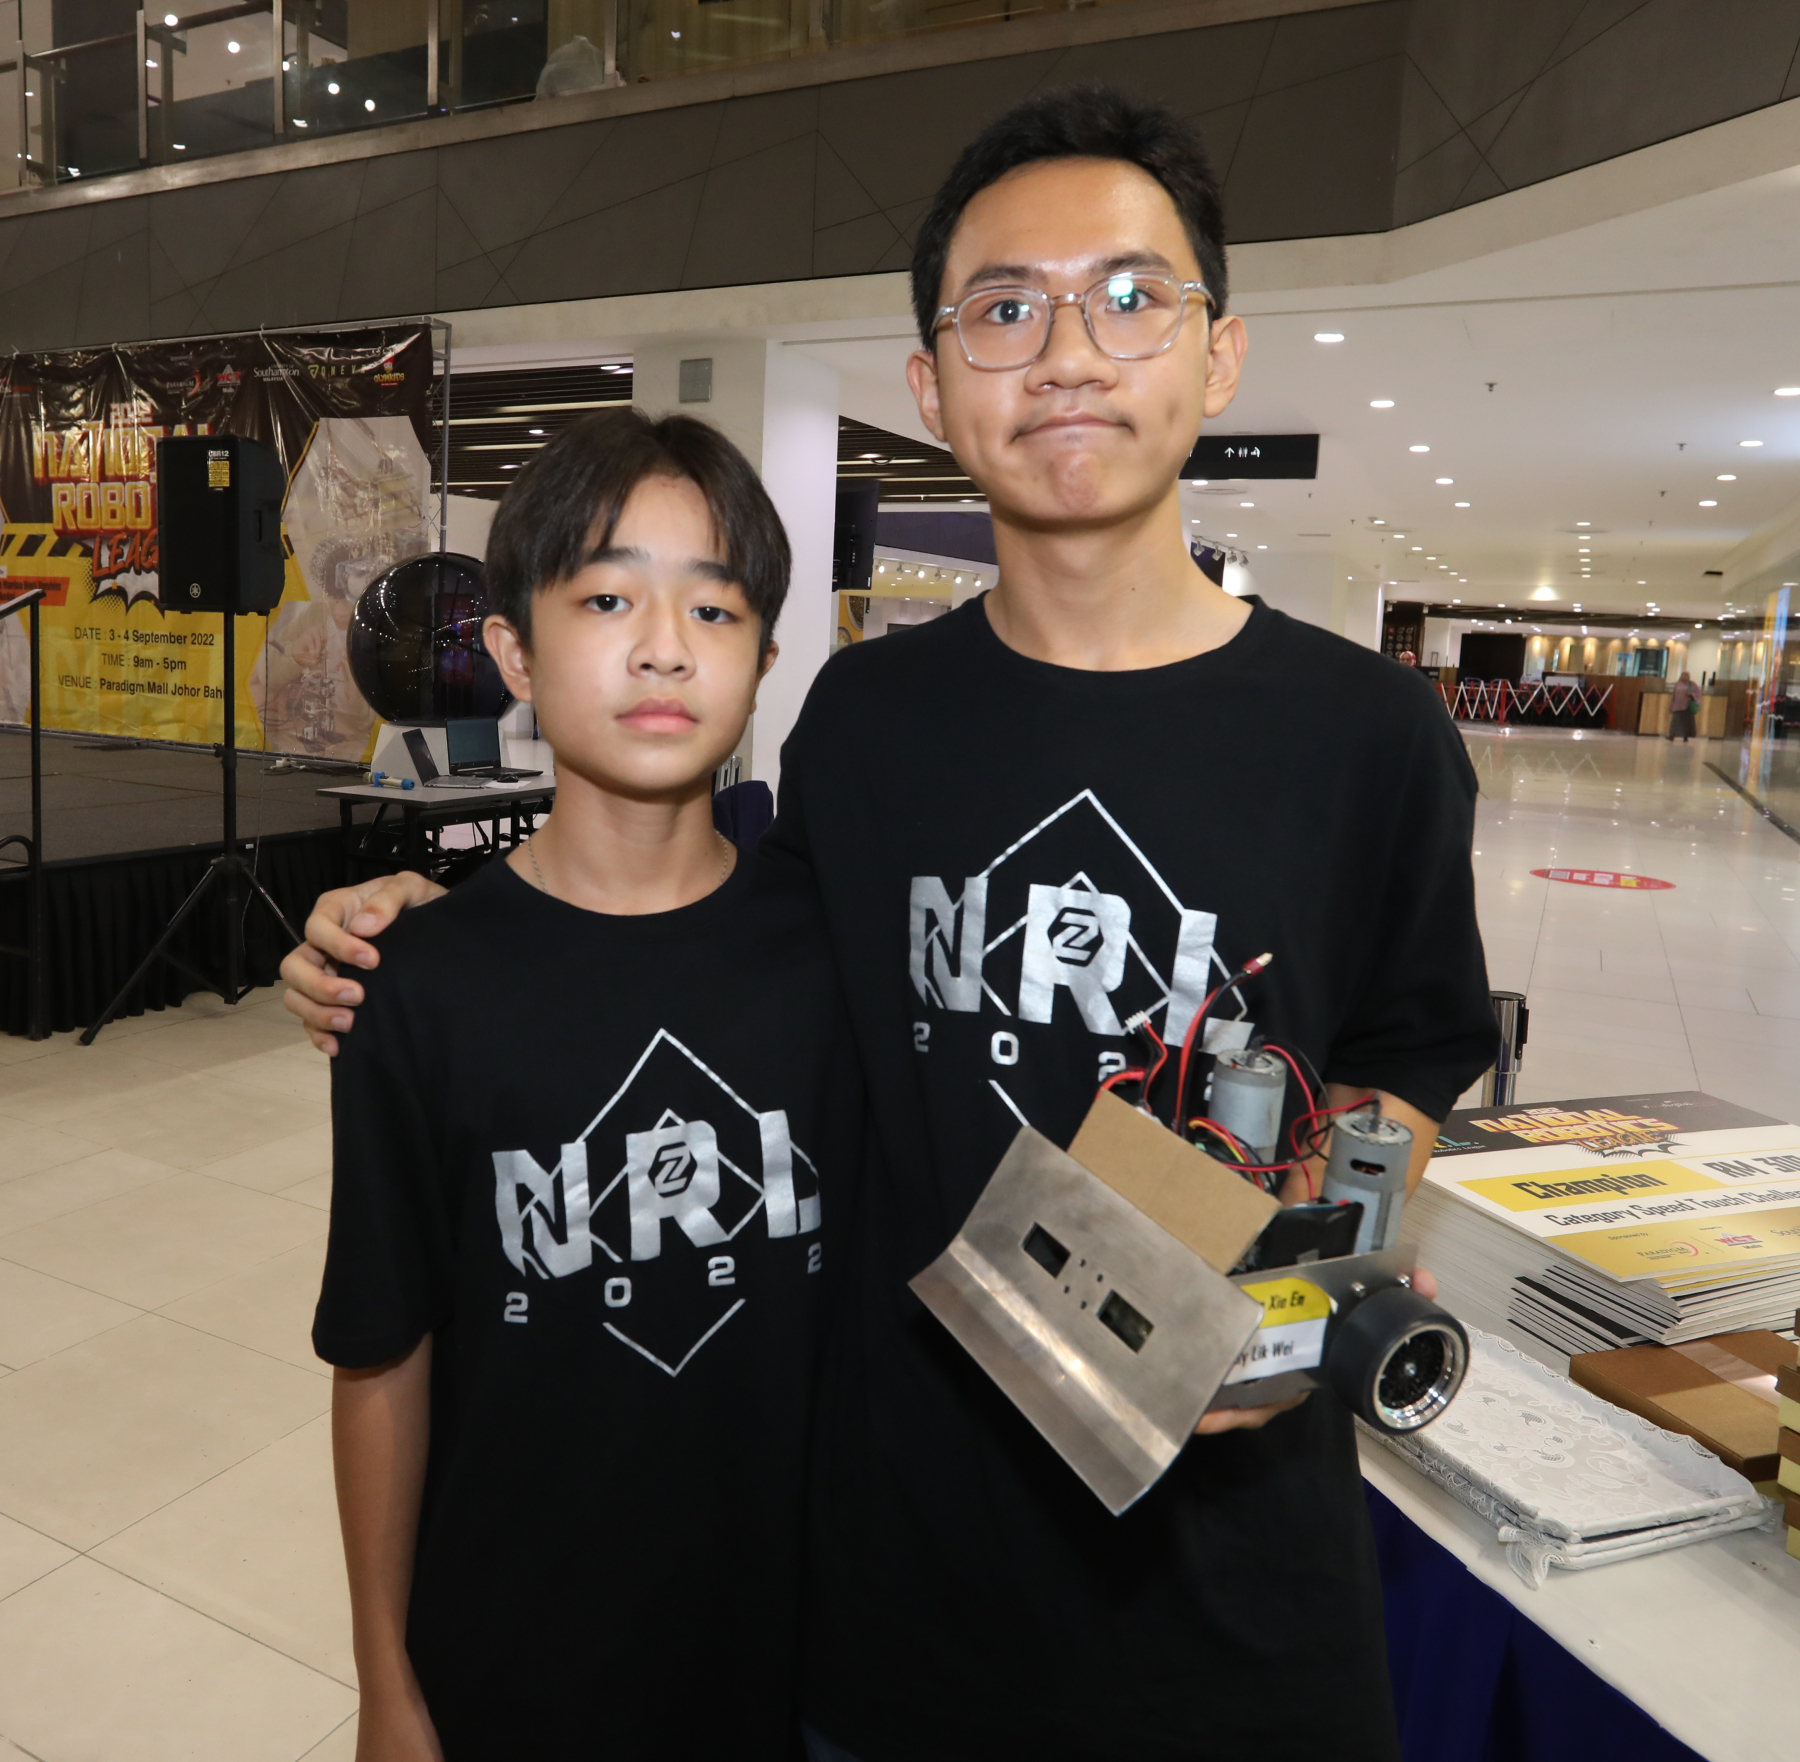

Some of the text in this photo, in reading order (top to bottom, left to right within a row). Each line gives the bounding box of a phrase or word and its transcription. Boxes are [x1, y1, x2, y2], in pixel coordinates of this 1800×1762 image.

[217, 371, 241, 382] WCT
[109, 402, 154, 425] 2022
[52, 482, 157, 529] ROBO
[74, 627, 102, 641] DATE
[132, 630, 187, 646] September
[190, 633, 215, 646] 2022
[101, 653, 125, 667] TIME
[133, 655, 153, 668] 9am
[163, 657, 187, 673] 5pm
[58, 675, 92, 689] VENUE
[100, 678, 144, 696] Paradigm
[147, 681, 168, 695] Mall
[171, 683, 200, 698] Johor
[909, 876, 1255, 1056] NRL
[1468, 1108, 1644, 1133] NATIONAL
[1521, 1107, 1564, 1115] 2022
[1510, 1118, 1680, 1143] ROBOTICS
[1575, 1130, 1664, 1151] LEAGUE
[1702, 1159, 1771, 1178] RM
[491, 1109, 822, 1279] NRL
[1511, 1173, 1668, 1199] Champion
[1543, 1206, 1640, 1227] Category
[1631, 1199, 1697, 1217] Speed
[1683, 1195, 1751, 1208] Touch
[1714, 1234, 1756, 1244] WCT
